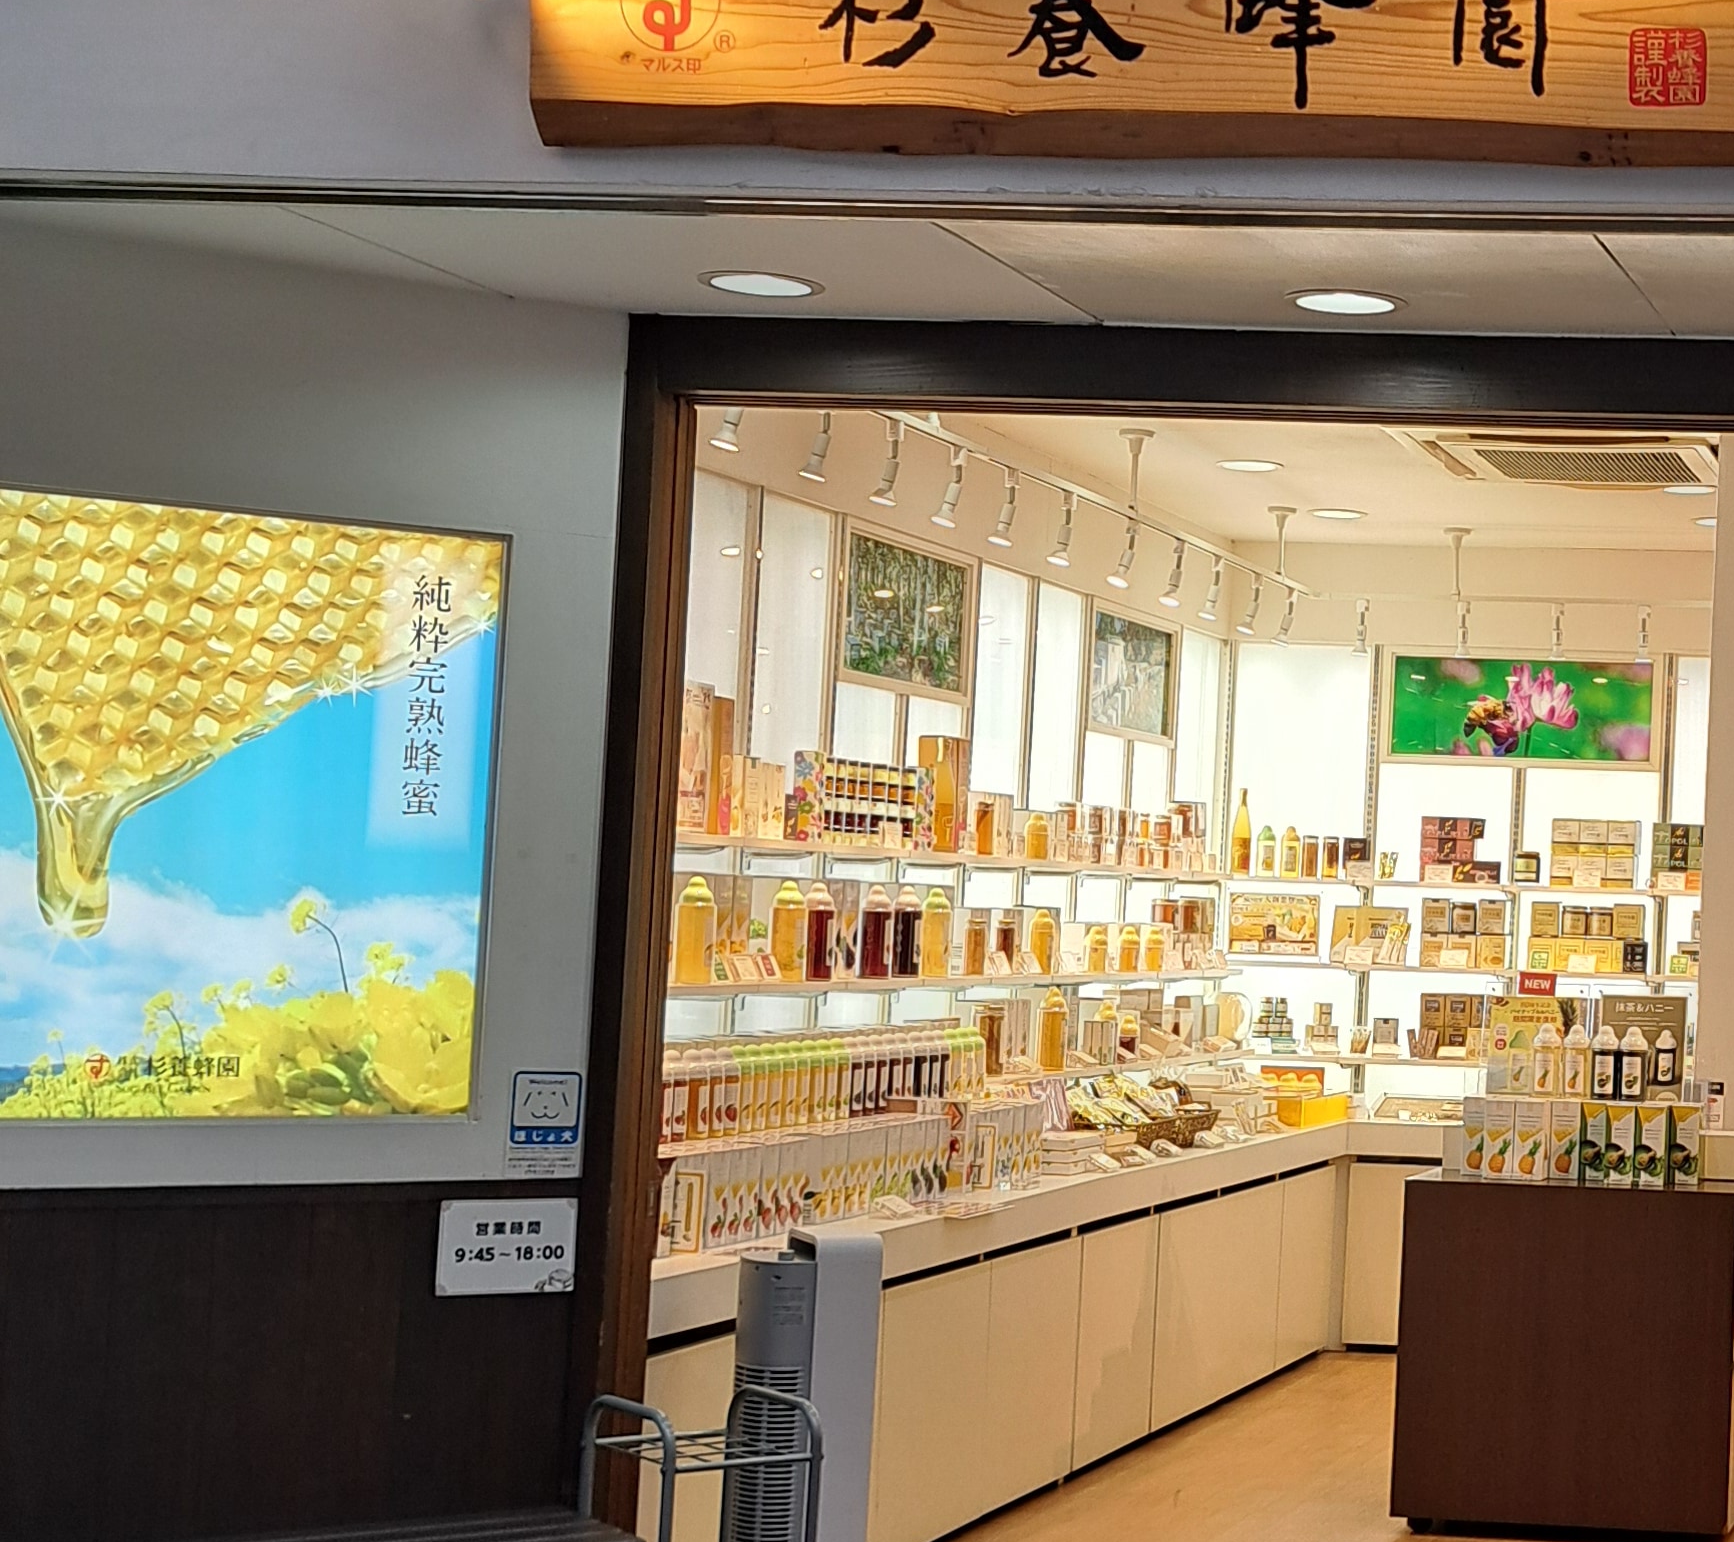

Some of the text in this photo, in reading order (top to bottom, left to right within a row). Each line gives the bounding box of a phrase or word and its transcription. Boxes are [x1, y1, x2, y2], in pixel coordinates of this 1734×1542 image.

[641, 57, 702, 75] マルス印
[401, 574, 452, 817] 純粋完熟蜂蜜
[1524, 979, 1551, 990] NEW
[475, 1221, 541, 1236] 営業時間
